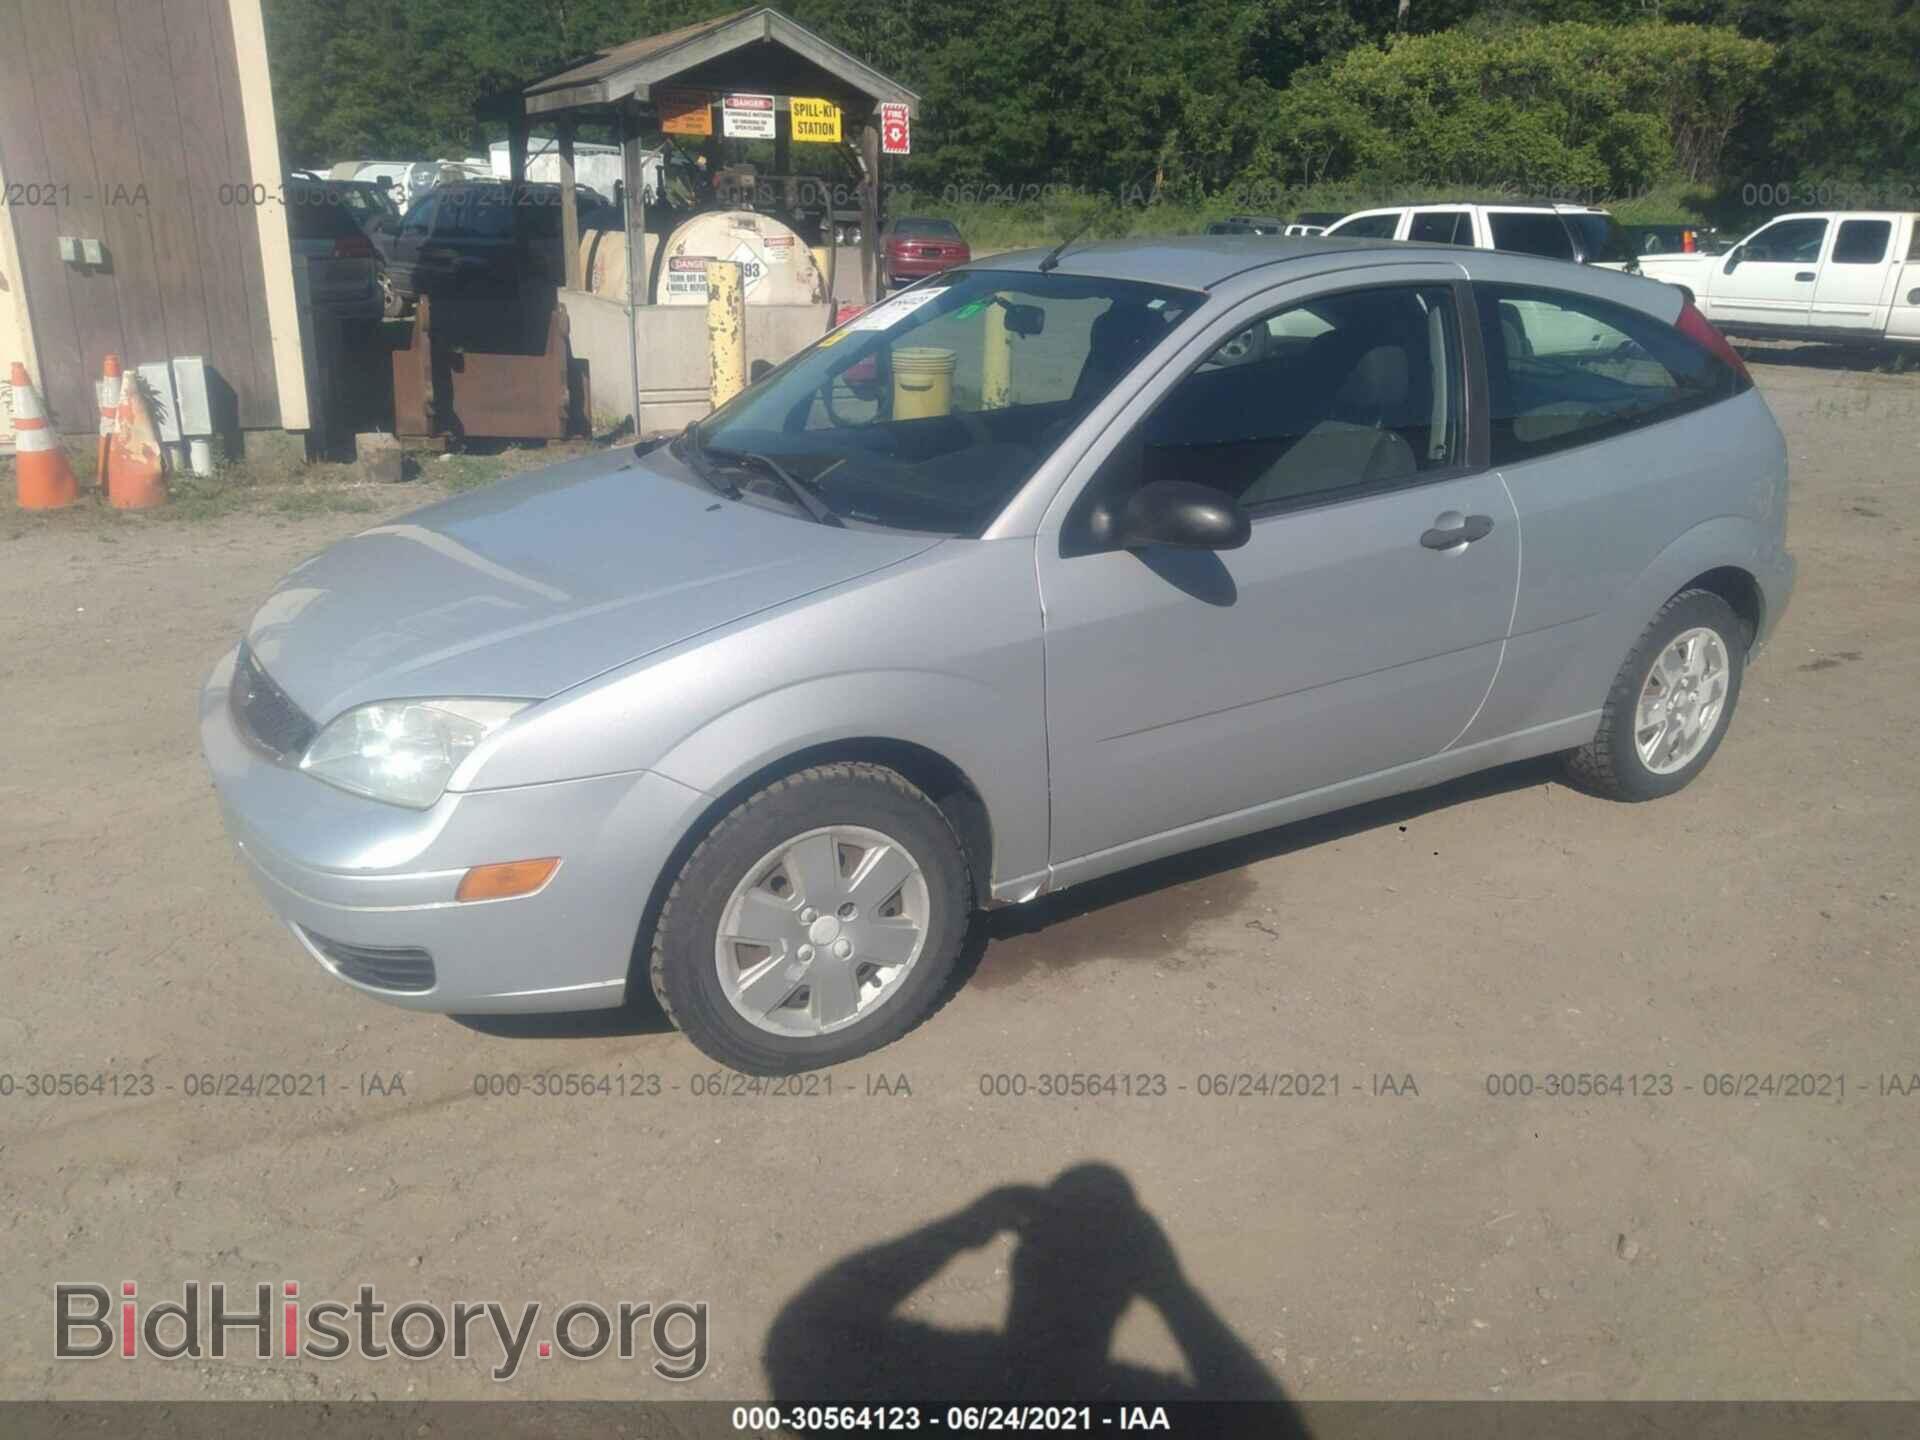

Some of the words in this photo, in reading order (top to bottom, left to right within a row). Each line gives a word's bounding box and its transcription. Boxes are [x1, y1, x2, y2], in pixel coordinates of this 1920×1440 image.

[794, 103, 837, 119] SPILL-KIT
[798, 121, 835, 135] STATION
[674, 259, 705, 270] DANGE
[744, 263, 760, 278] 93
